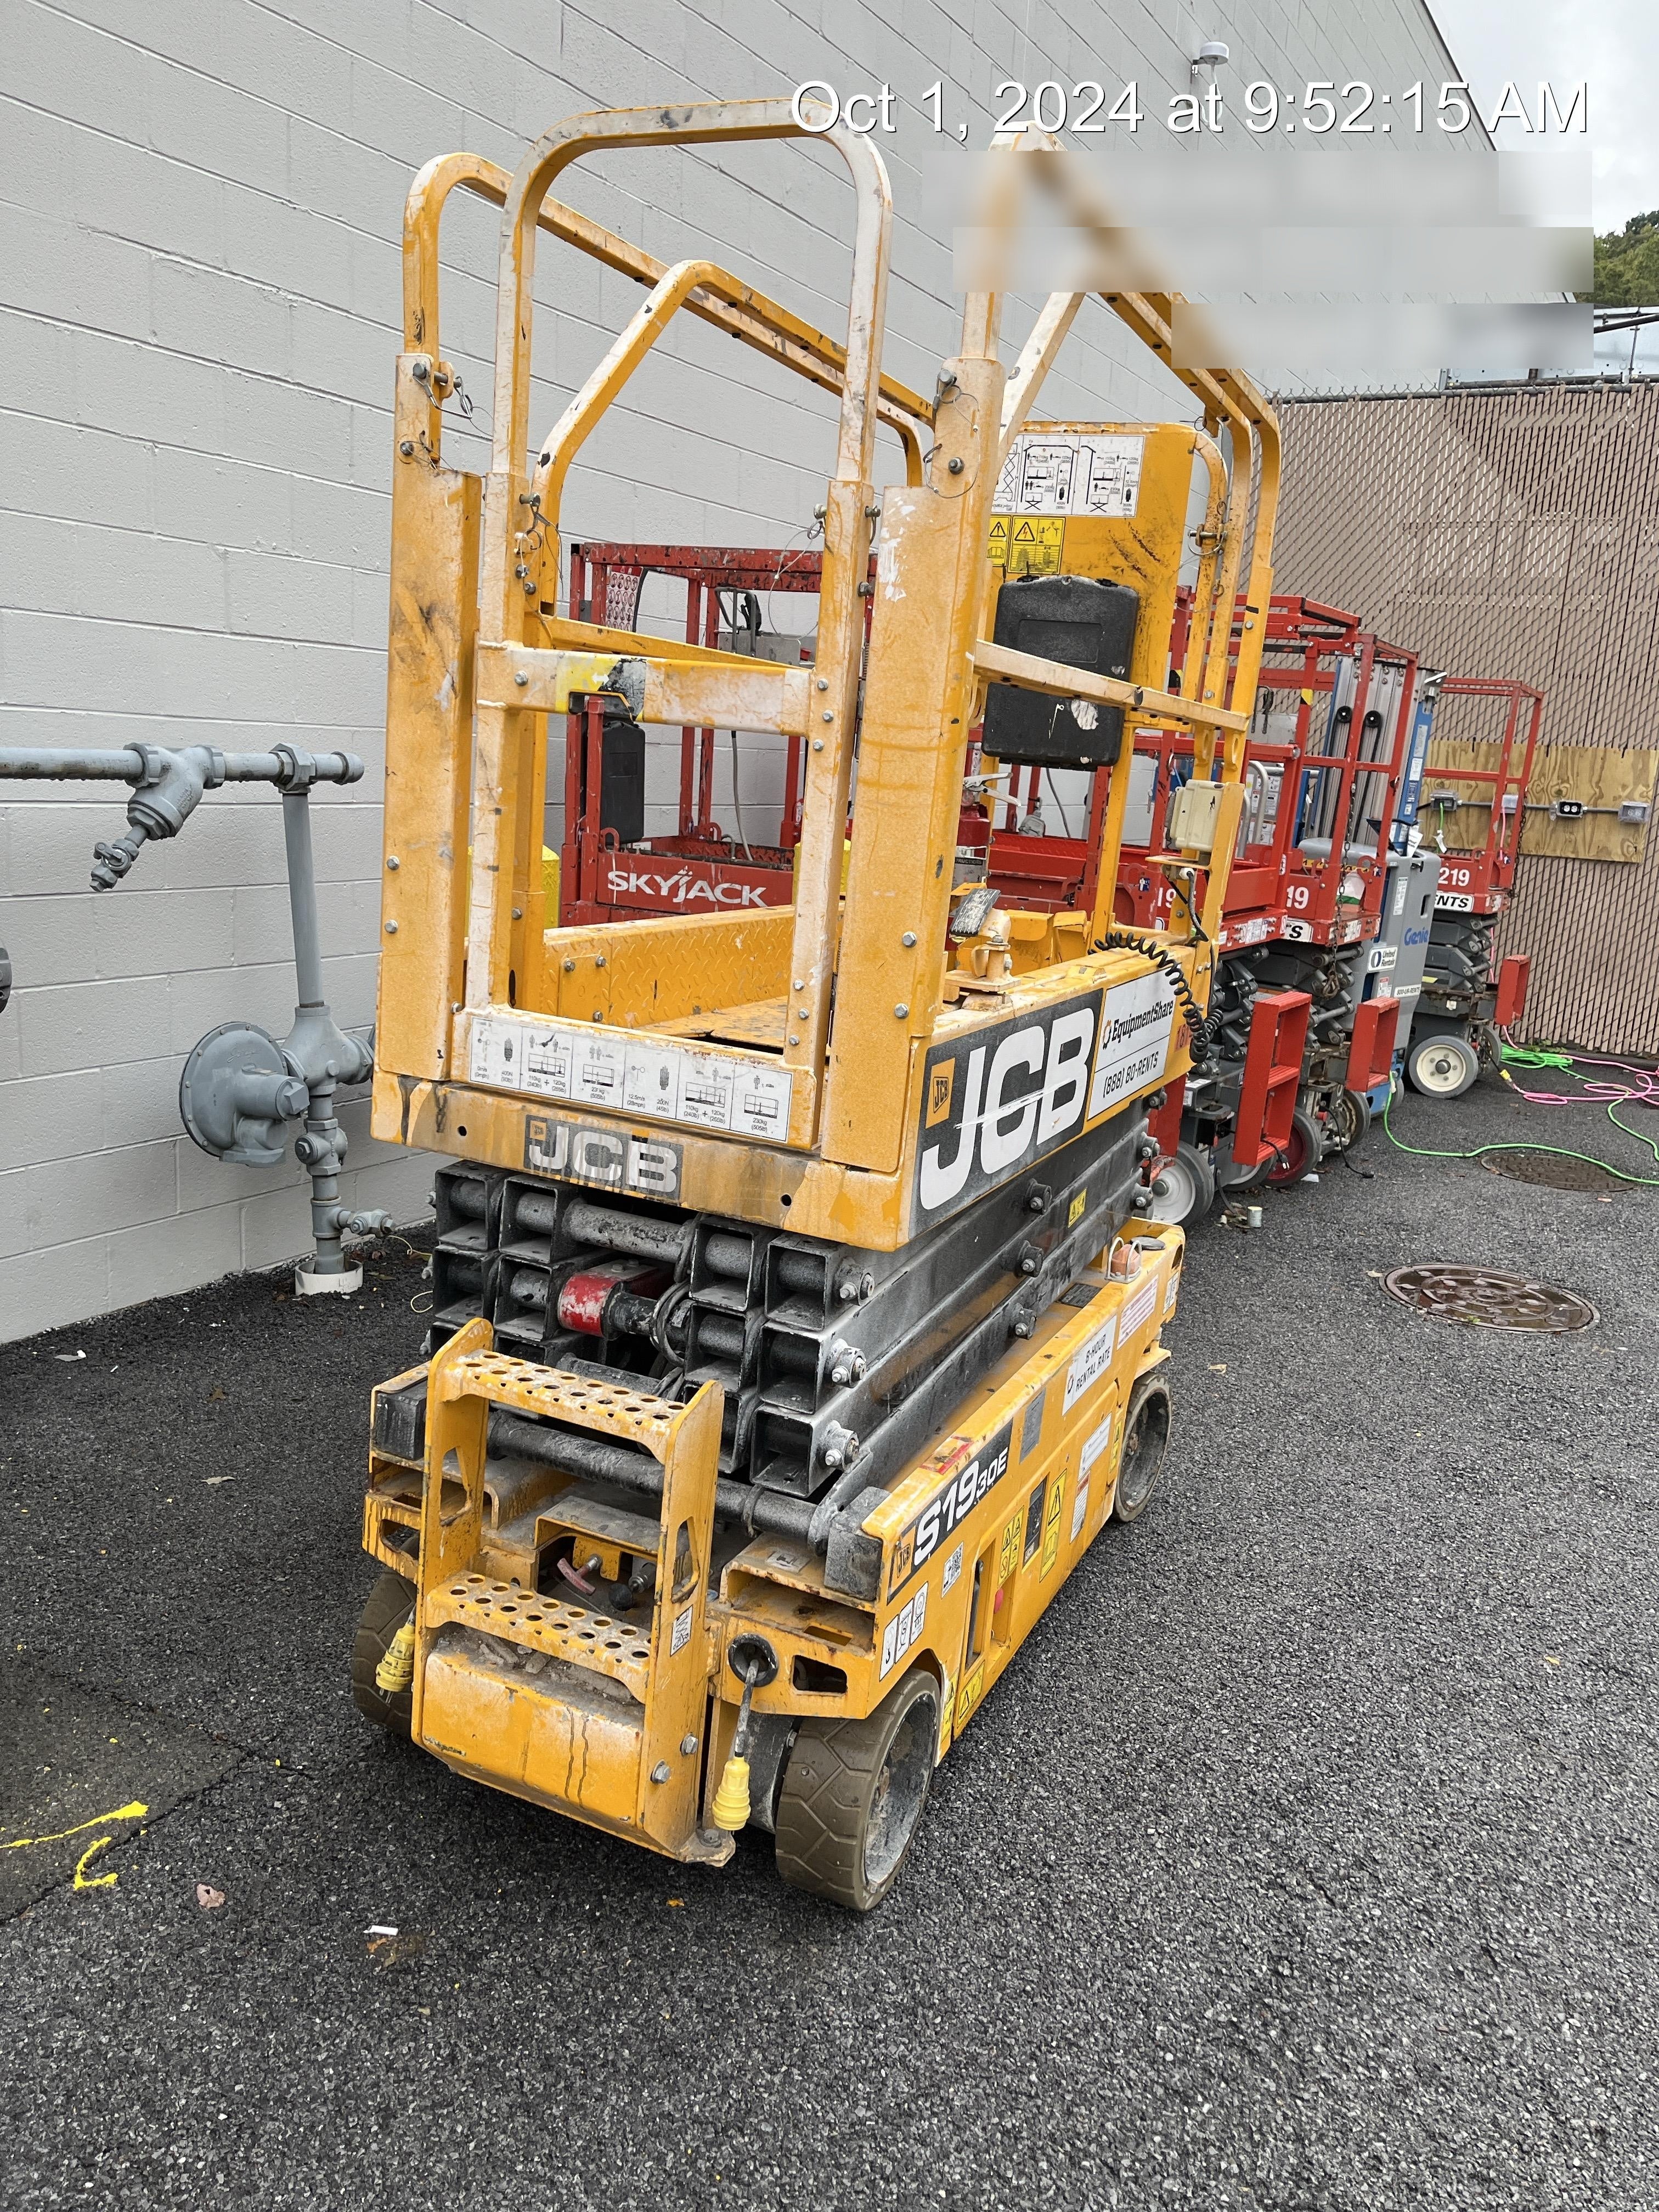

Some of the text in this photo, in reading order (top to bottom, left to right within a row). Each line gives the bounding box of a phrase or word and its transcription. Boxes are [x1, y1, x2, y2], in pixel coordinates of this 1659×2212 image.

[608, 865, 767, 909] SKYJACK
[1438, 866, 1470, 887] 219
[1404, 926, 1429, 946] Genie
[1111, 1000, 1174, 1043] EquipmentShare
[934, 1078, 949, 1106] JCB
[1103, 1051, 1159, 1098] (888) 80-RENTS
[752, 1118, 768, 1126] 230kg
[919, 1007, 1094, 1210] JCB
[529, 1126, 677, 1192] JCB
[1076, 1345, 1111, 1392] RENTAL RATE
